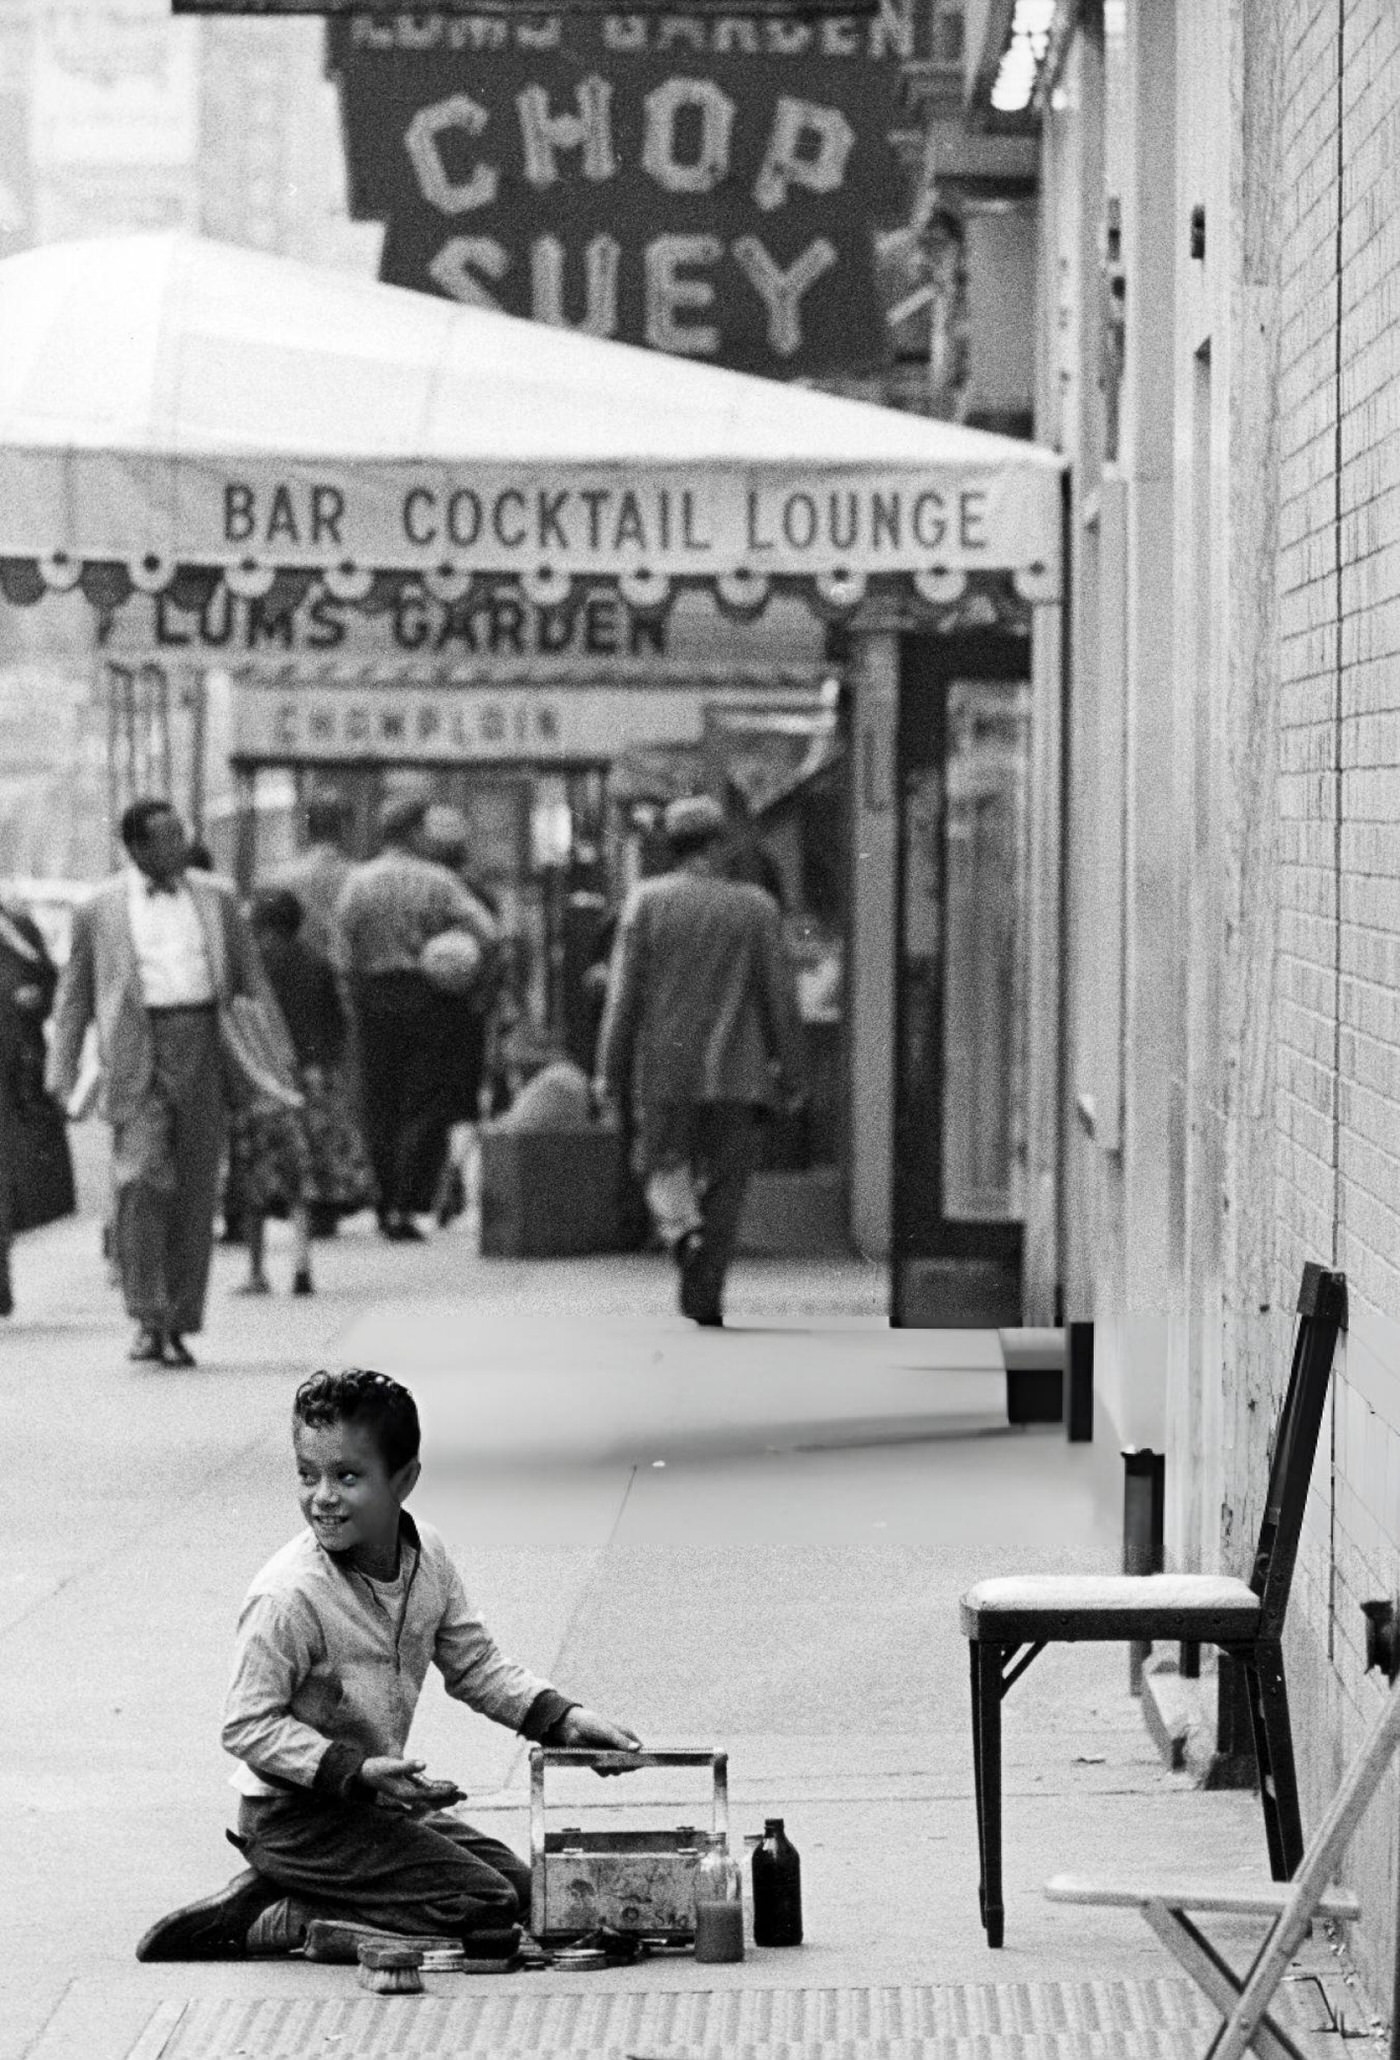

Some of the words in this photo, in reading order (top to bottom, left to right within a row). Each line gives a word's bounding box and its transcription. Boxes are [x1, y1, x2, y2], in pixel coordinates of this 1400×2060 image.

[405, 76, 856, 213] CHOP
[428, 232, 838, 356] SUEY
[223, 483, 345, 545] BAR
[401, 486, 712, 551] COCKTAIL
[746, 489, 988, 551] LOUNGE
[155, 590, 348, 650] LUMS
[394, 596, 668, 656] GARDEN
